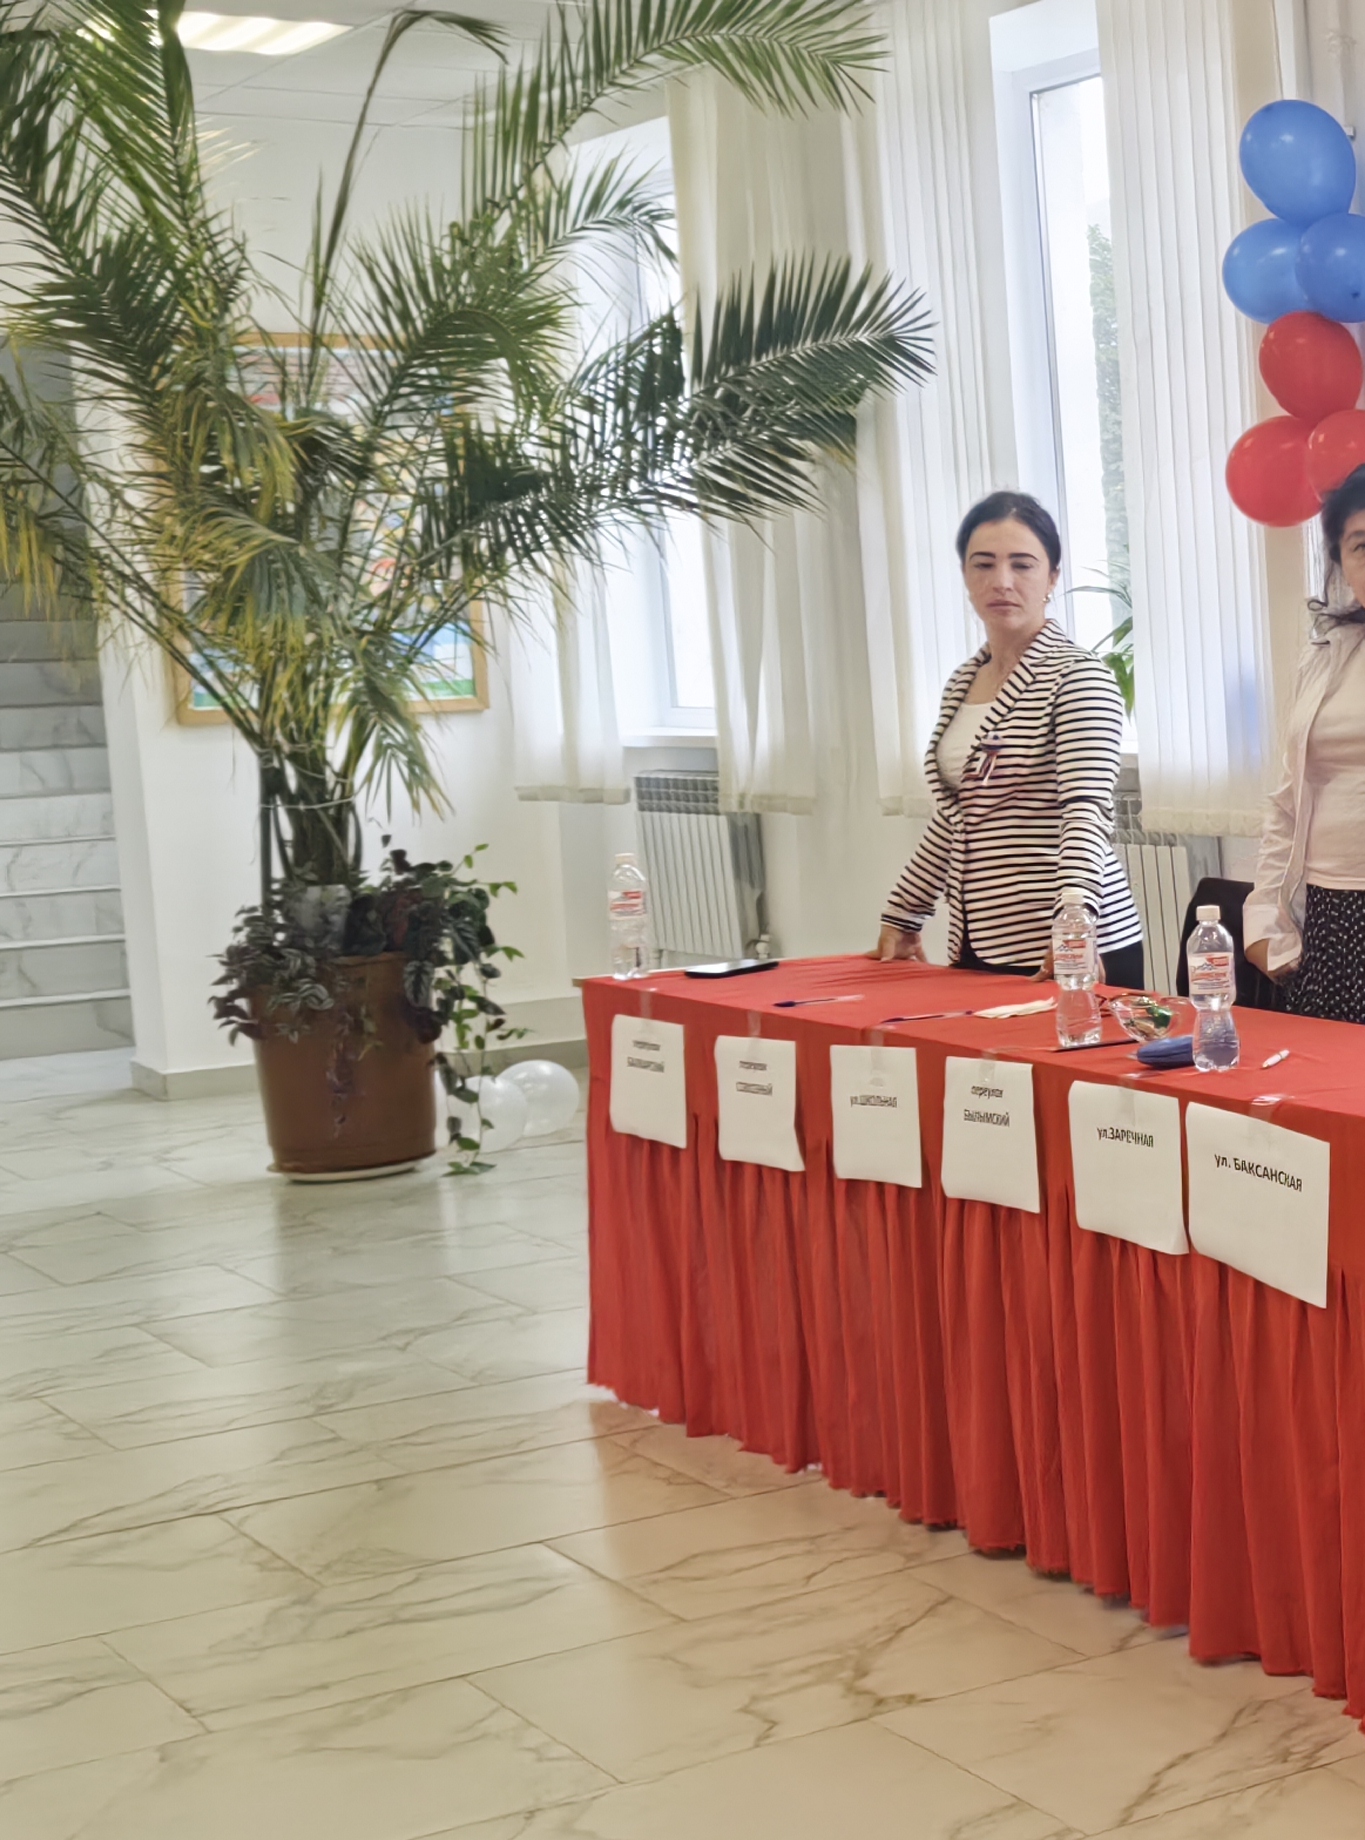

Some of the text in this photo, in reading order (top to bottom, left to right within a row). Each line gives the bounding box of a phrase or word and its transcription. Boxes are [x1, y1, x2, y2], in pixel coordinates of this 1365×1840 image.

[1096, 1126, 1154, 1148] ул.ЗАРЕЧНАЯ
[1214, 1153, 1303, 1192] ул. БАКСАНСКАЯ
